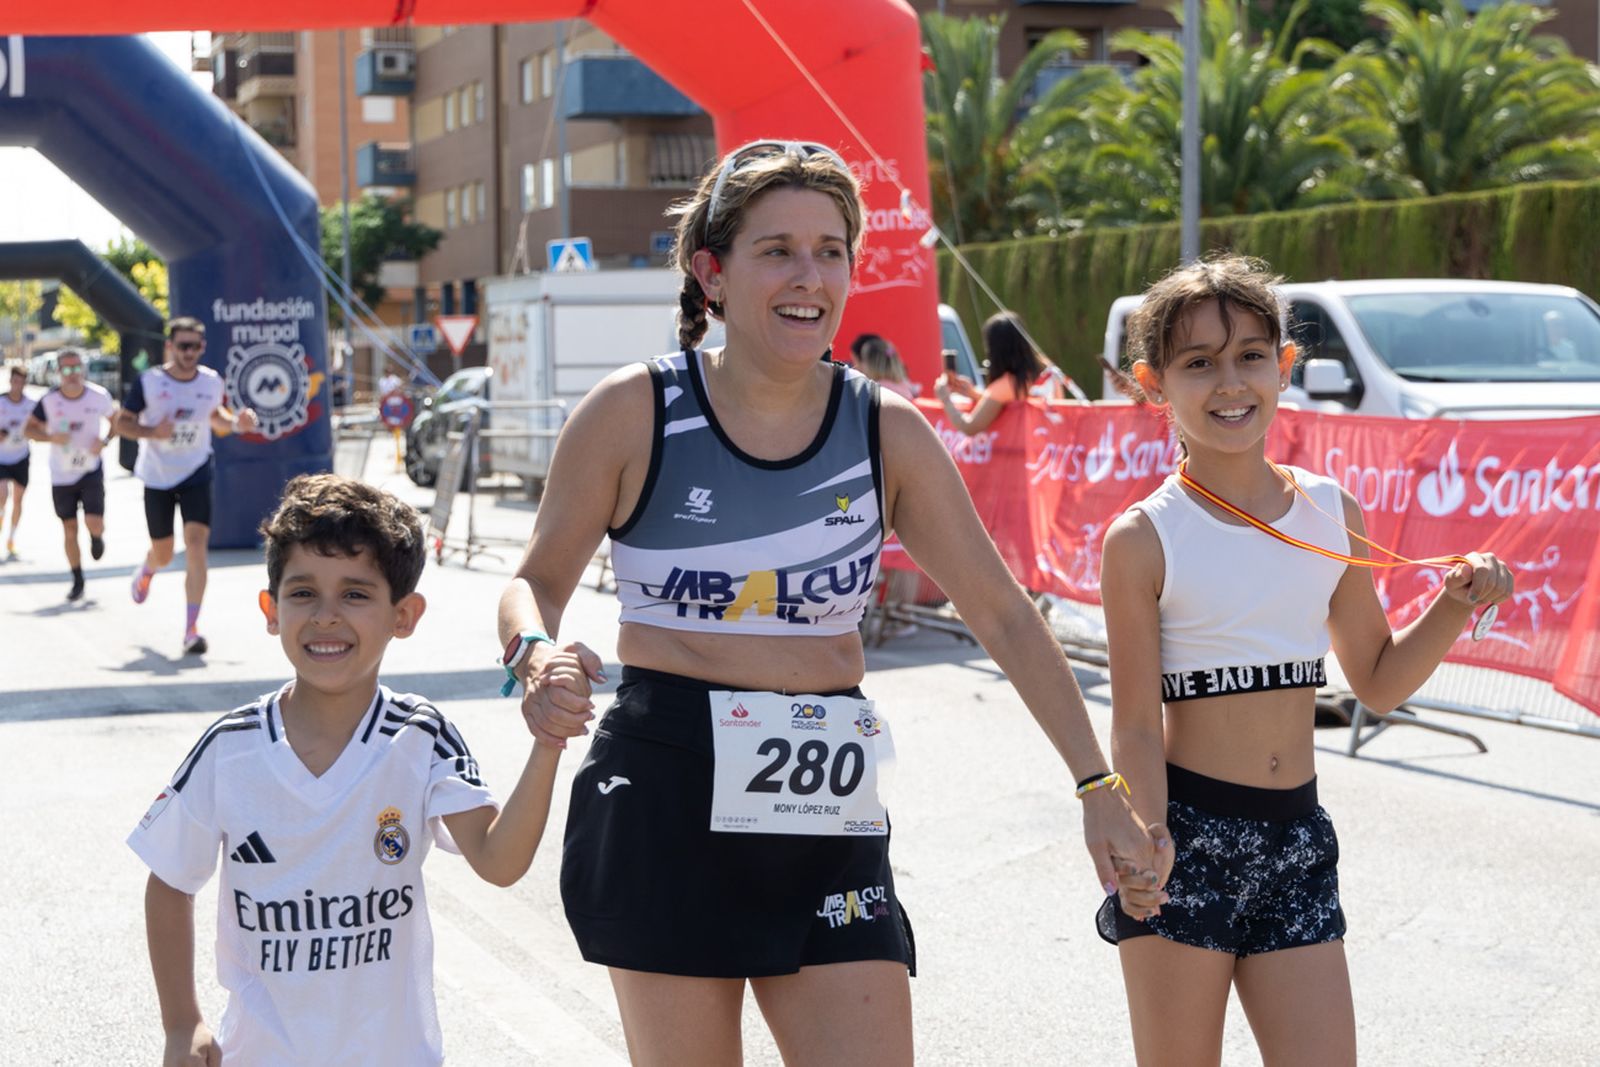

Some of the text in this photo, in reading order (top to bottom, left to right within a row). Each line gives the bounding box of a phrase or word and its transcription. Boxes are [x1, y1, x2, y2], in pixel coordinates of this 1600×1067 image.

[212, 296, 315, 322] fundación
[231, 321, 300, 345] mupol
[824, 514, 865, 526] SPALL
[719, 718, 762, 728] Santander
[745, 737, 865, 797] 280
[773, 802, 841, 815] MONY LÓPEZ RUIZ
[233, 884, 414, 932] Emirates
[260, 928, 392, 972] FLY BETTER
